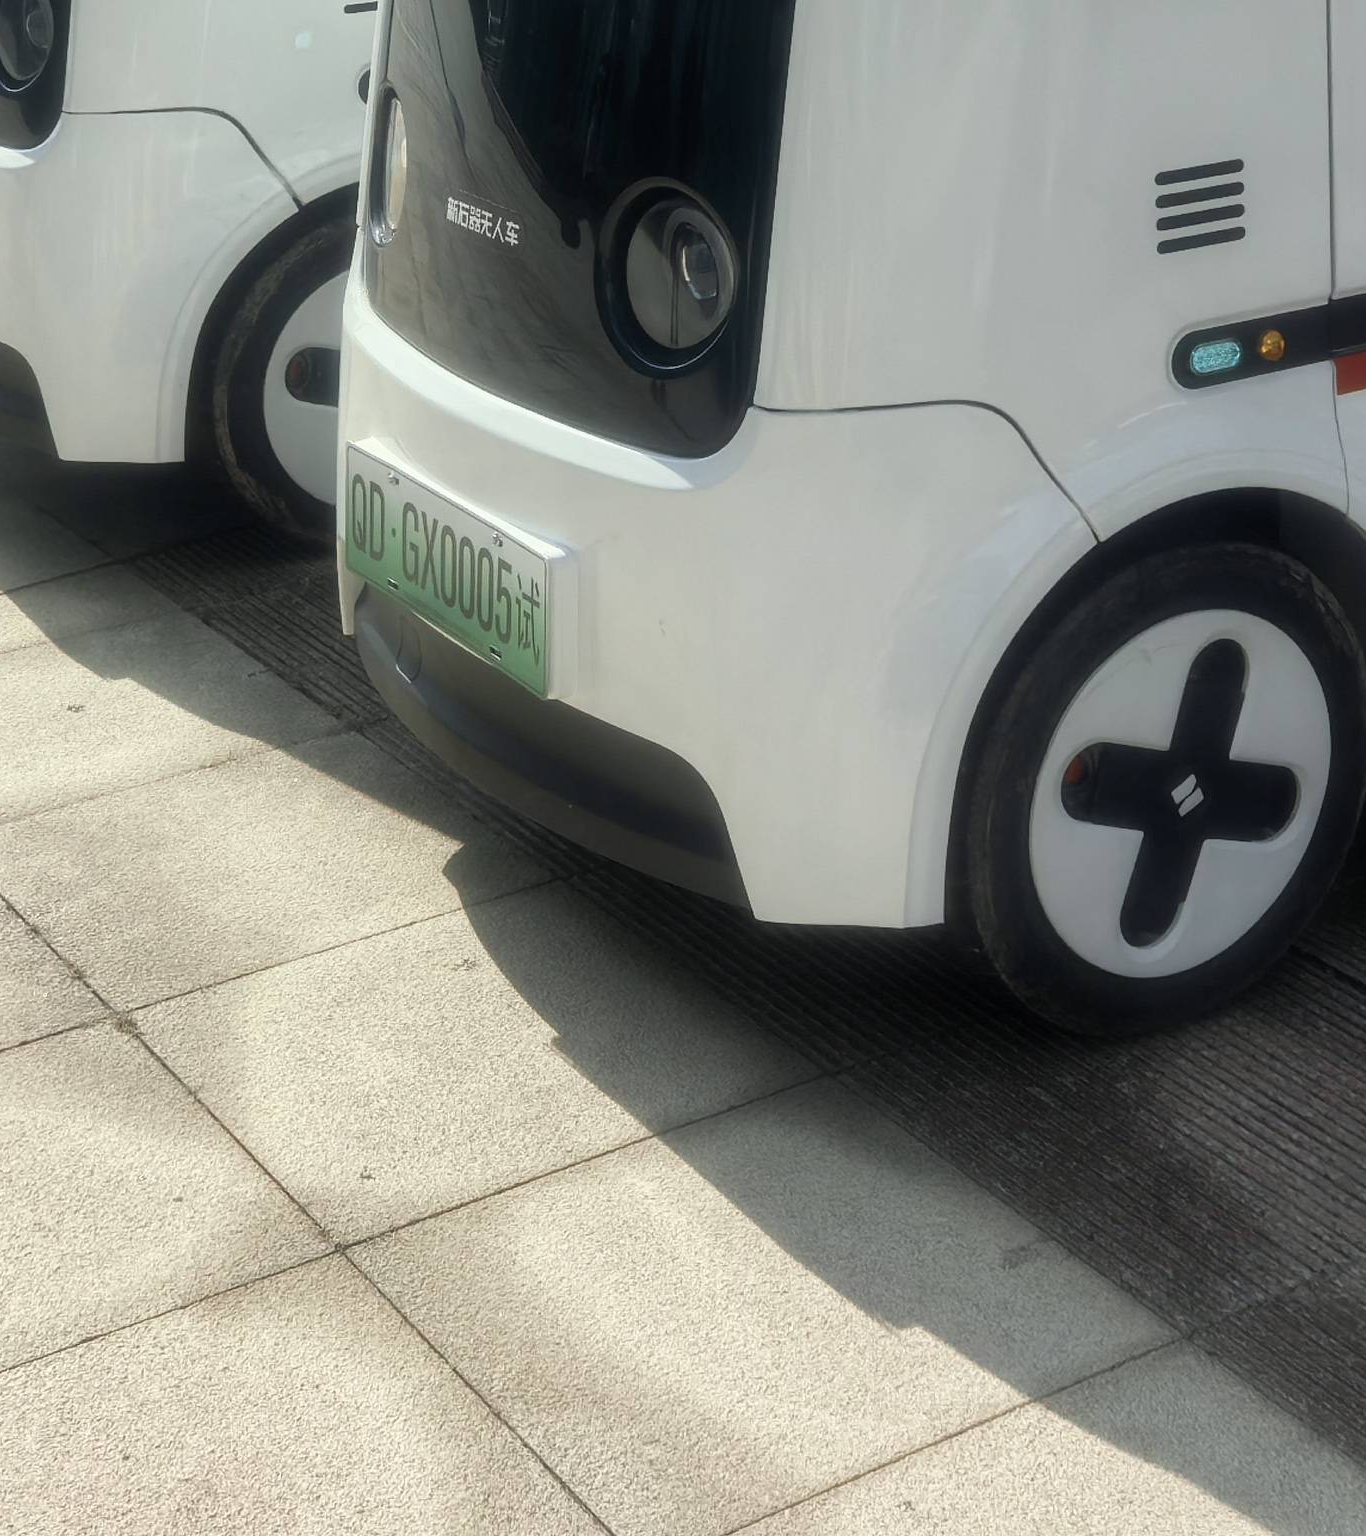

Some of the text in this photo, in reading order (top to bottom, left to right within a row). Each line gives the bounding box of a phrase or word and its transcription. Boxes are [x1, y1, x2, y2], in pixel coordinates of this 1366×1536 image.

[446, 196, 520, 247] 新石器无人车
